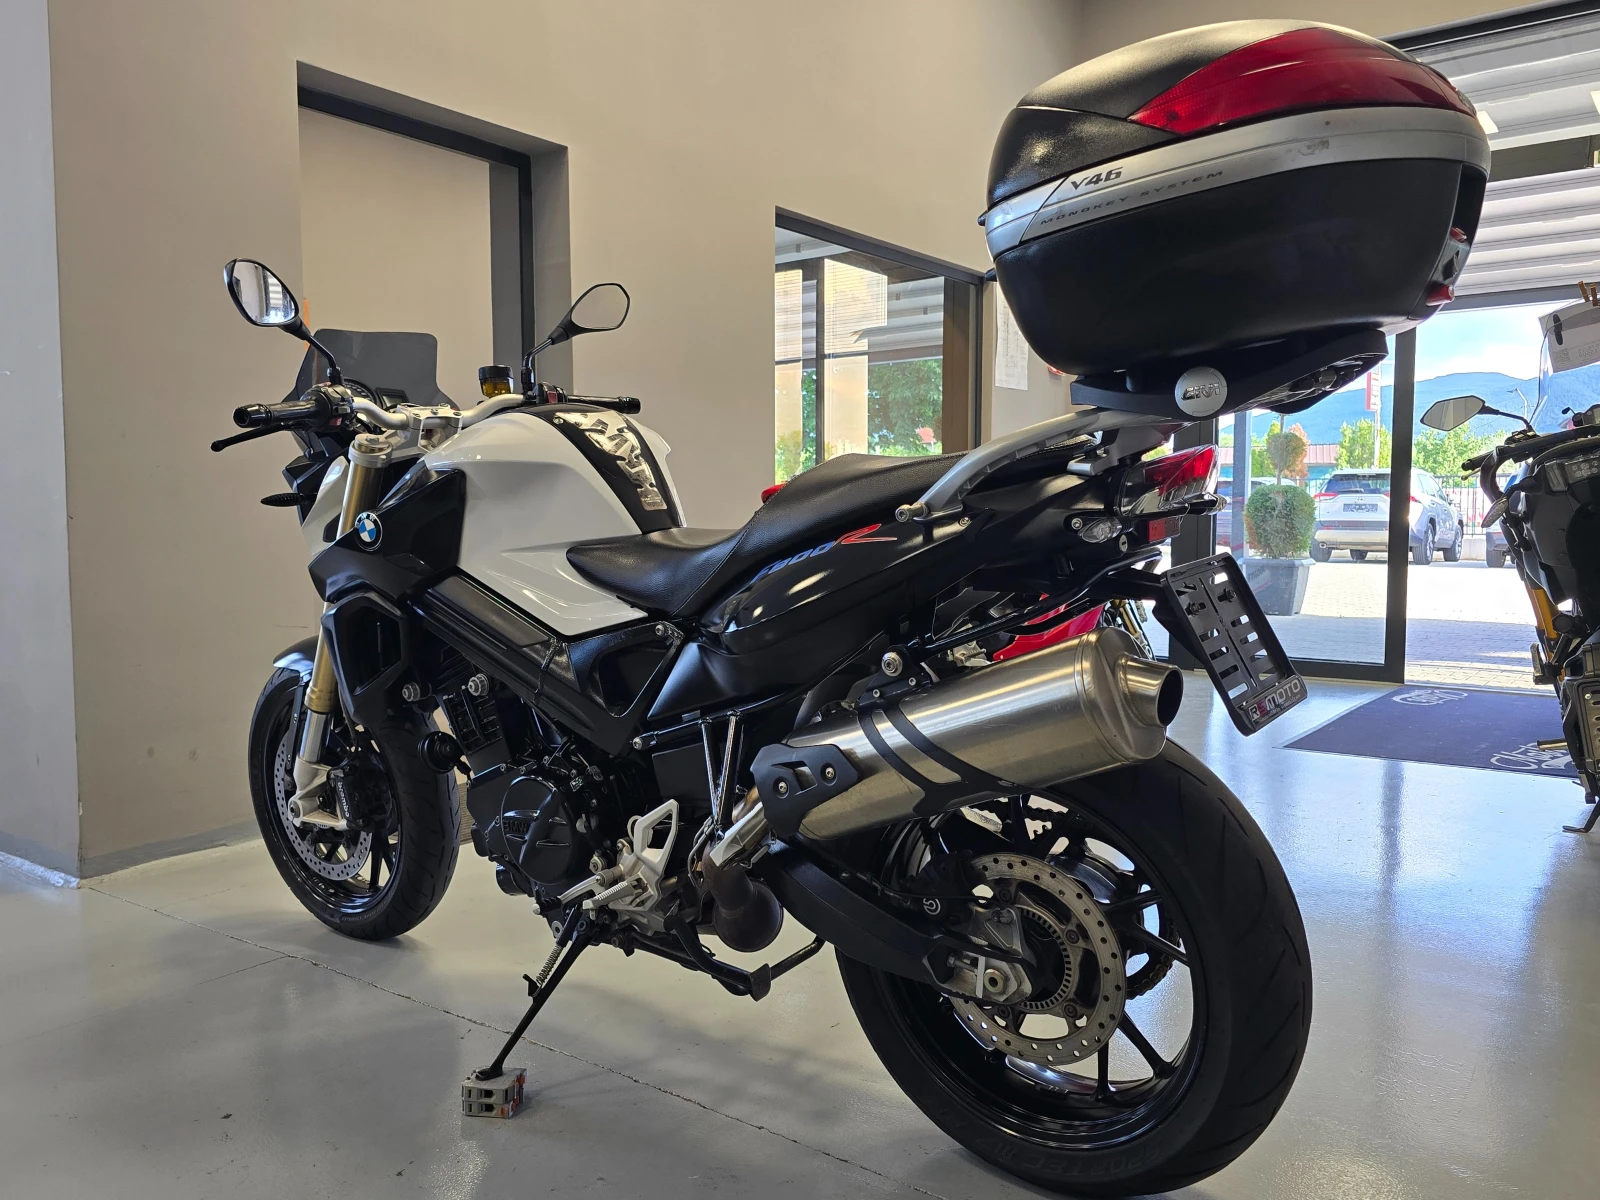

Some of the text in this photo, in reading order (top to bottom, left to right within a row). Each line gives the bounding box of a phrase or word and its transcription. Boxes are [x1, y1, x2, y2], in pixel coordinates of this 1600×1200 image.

[1070, 166, 1124, 191] V46
[1040, 170, 1223, 226] MONOKEY SYSTEM
[1181, 382, 1220, 401] GIVI
[337, 781, 350, 818] brembo
